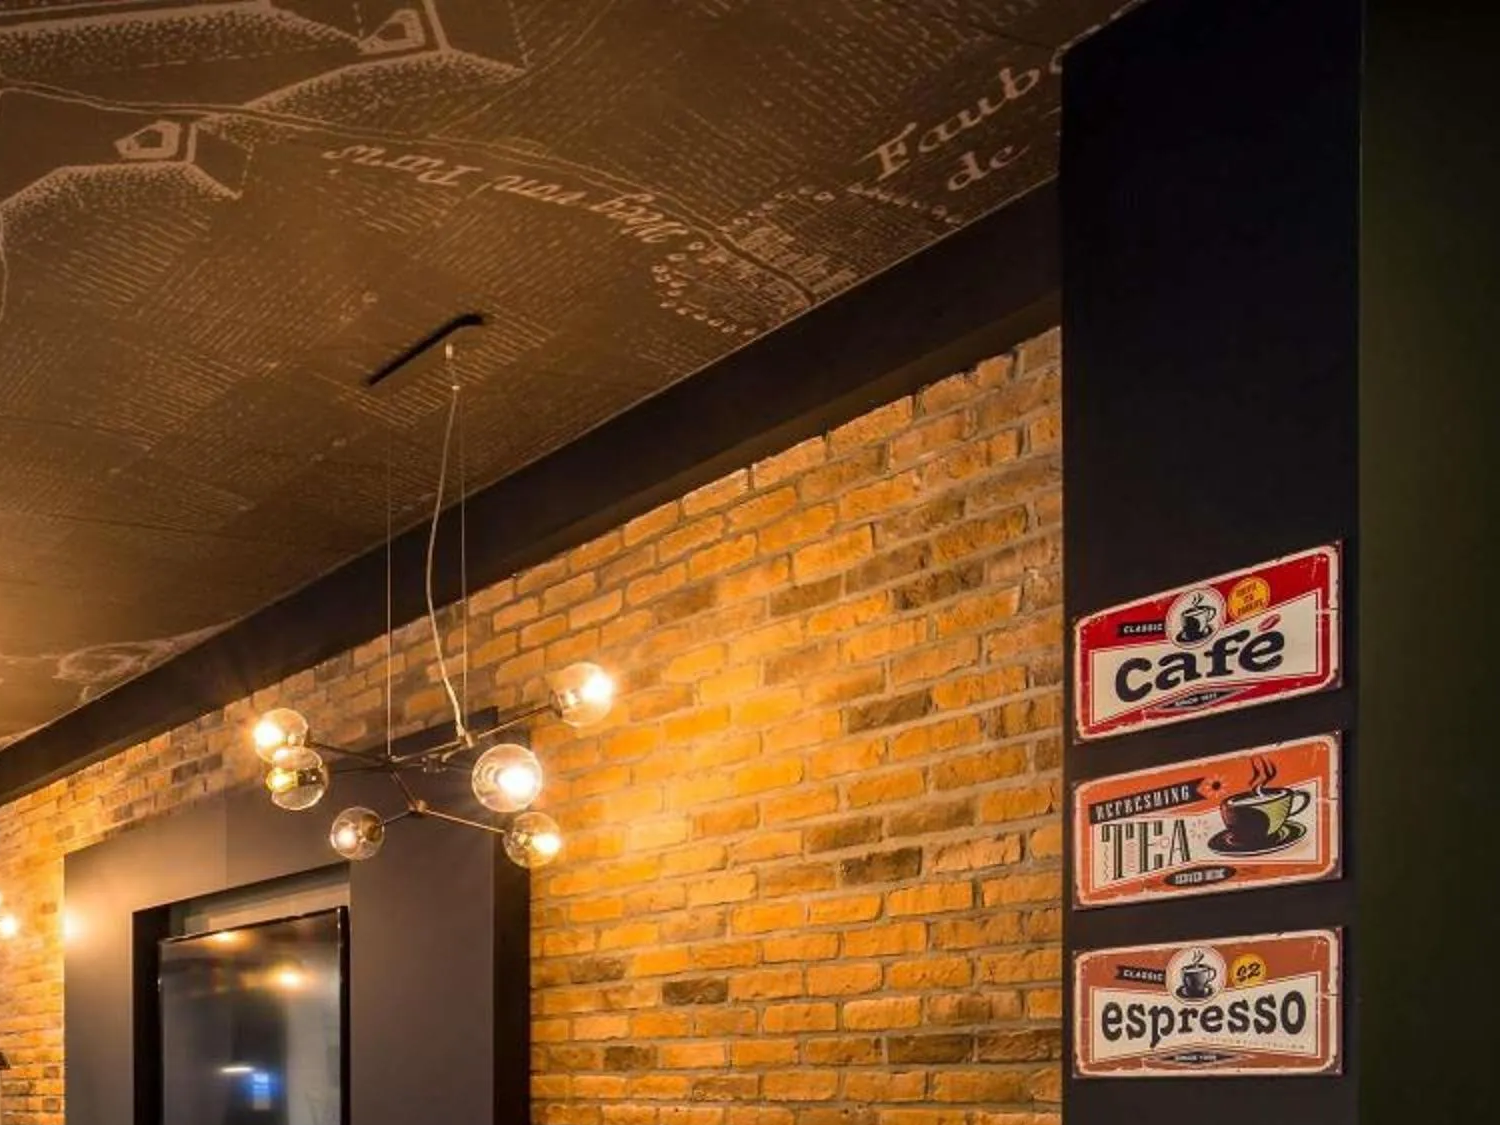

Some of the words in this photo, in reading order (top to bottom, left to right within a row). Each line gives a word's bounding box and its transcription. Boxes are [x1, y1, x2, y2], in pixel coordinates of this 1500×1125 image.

[853, 45, 1062, 182] Faub
[947, 146, 1031, 191] de
[1122, 623, 1164, 635] CLASSIC
[1114, 613, 1286, 703] café
[1096, 784, 1190, 821] REFRESHING
[1101, 819, 1191, 881] TEA
[1122, 969, 1164, 982] CLASSIC
[1101, 990, 1307, 1048] espresso
